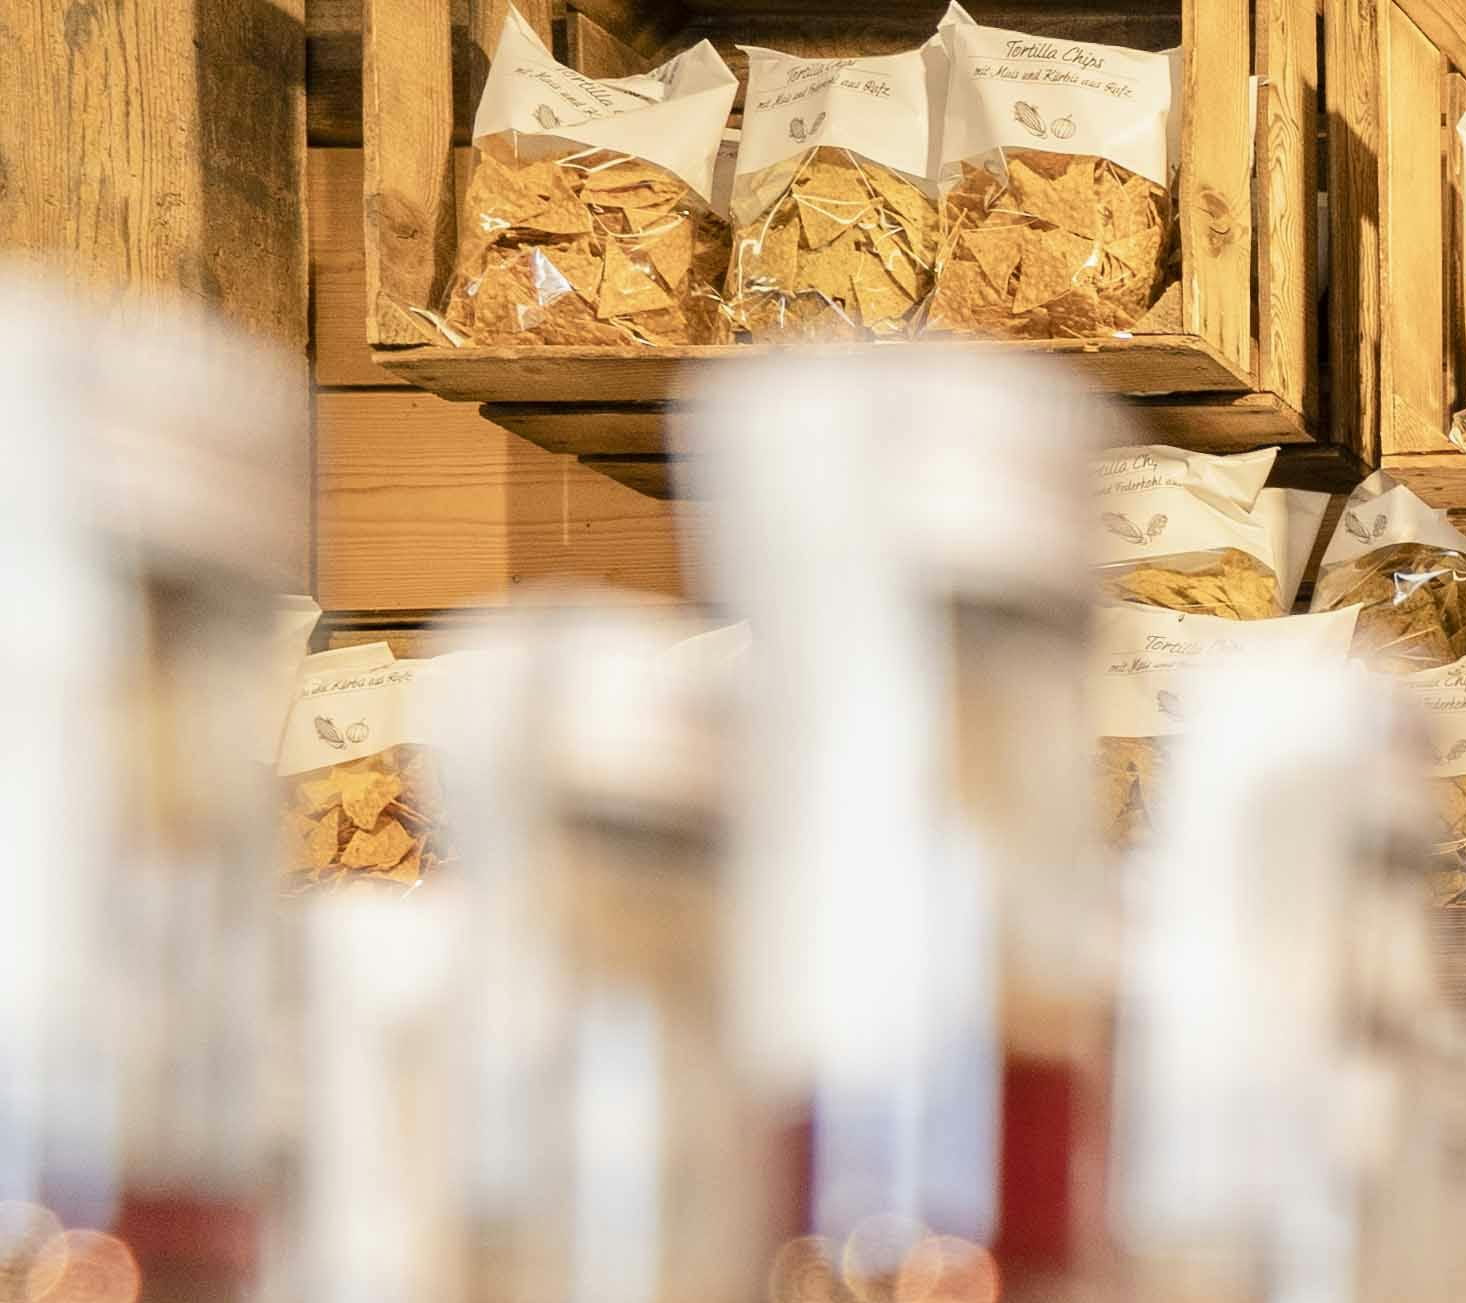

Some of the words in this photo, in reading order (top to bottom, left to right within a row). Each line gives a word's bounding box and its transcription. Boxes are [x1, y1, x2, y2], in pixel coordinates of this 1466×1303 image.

[1006, 40, 1057, 60] Tortilla
[1062, 47, 1105, 70] Chips
[840, 79, 859, 89] aus
[973, 66, 990, 77] mit
[991, 65, 1018, 79] Mais
[1022, 69, 1040, 80] und
[1042, 68, 1078, 84] Kürbis
[1081, 79, 1101, 89] aus
